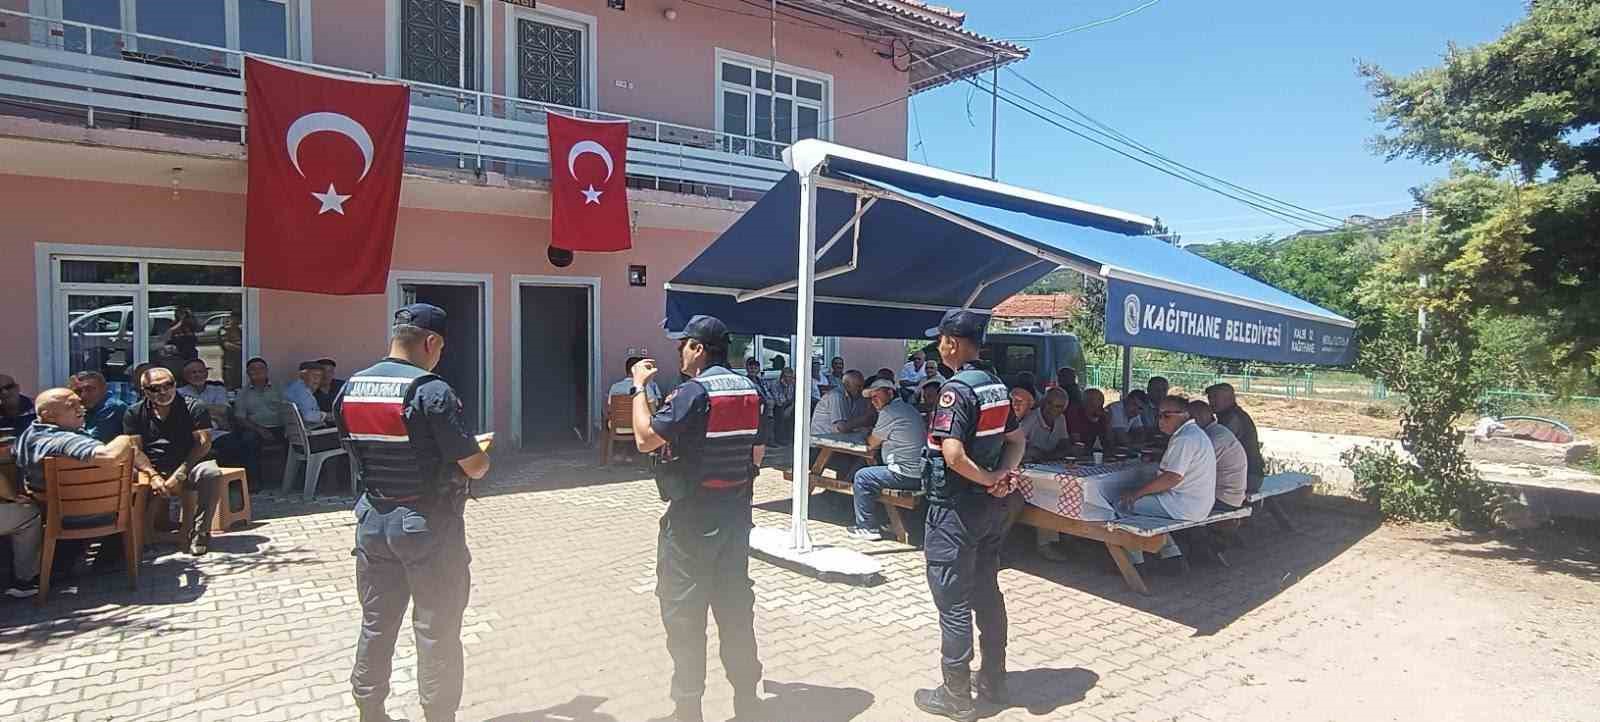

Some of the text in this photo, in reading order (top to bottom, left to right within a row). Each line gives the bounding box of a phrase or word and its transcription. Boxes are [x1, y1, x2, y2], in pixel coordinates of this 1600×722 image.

[1143, 302, 1281, 346] KAĞITHANE BELEDİYESİ
[350, 382, 400, 396] JANDARMA
